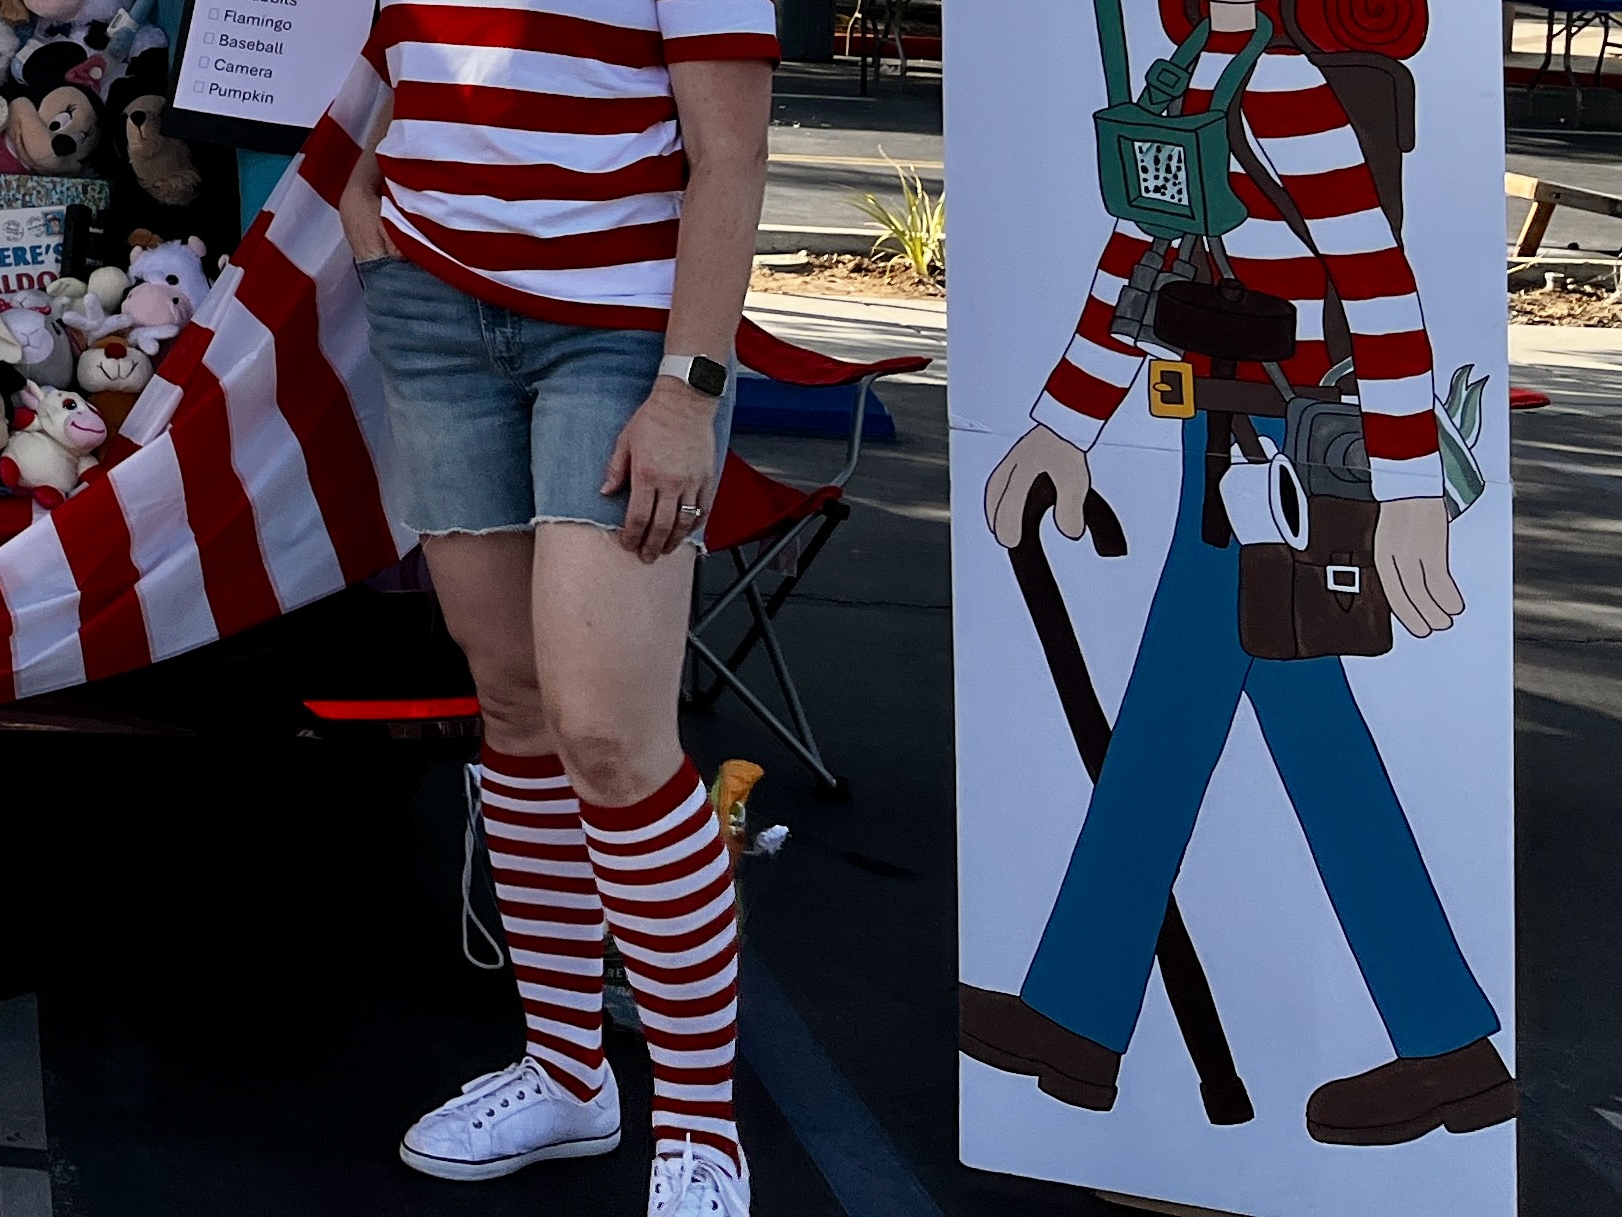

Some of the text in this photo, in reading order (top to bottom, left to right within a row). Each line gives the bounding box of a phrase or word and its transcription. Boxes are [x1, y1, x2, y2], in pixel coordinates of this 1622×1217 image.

[223, 10, 293, 32] Flamingo
[218, 34, 284, 55] Baseball
[214, 58, 274, 79] Camera
[208, 82, 274, 105] Pumpkin
